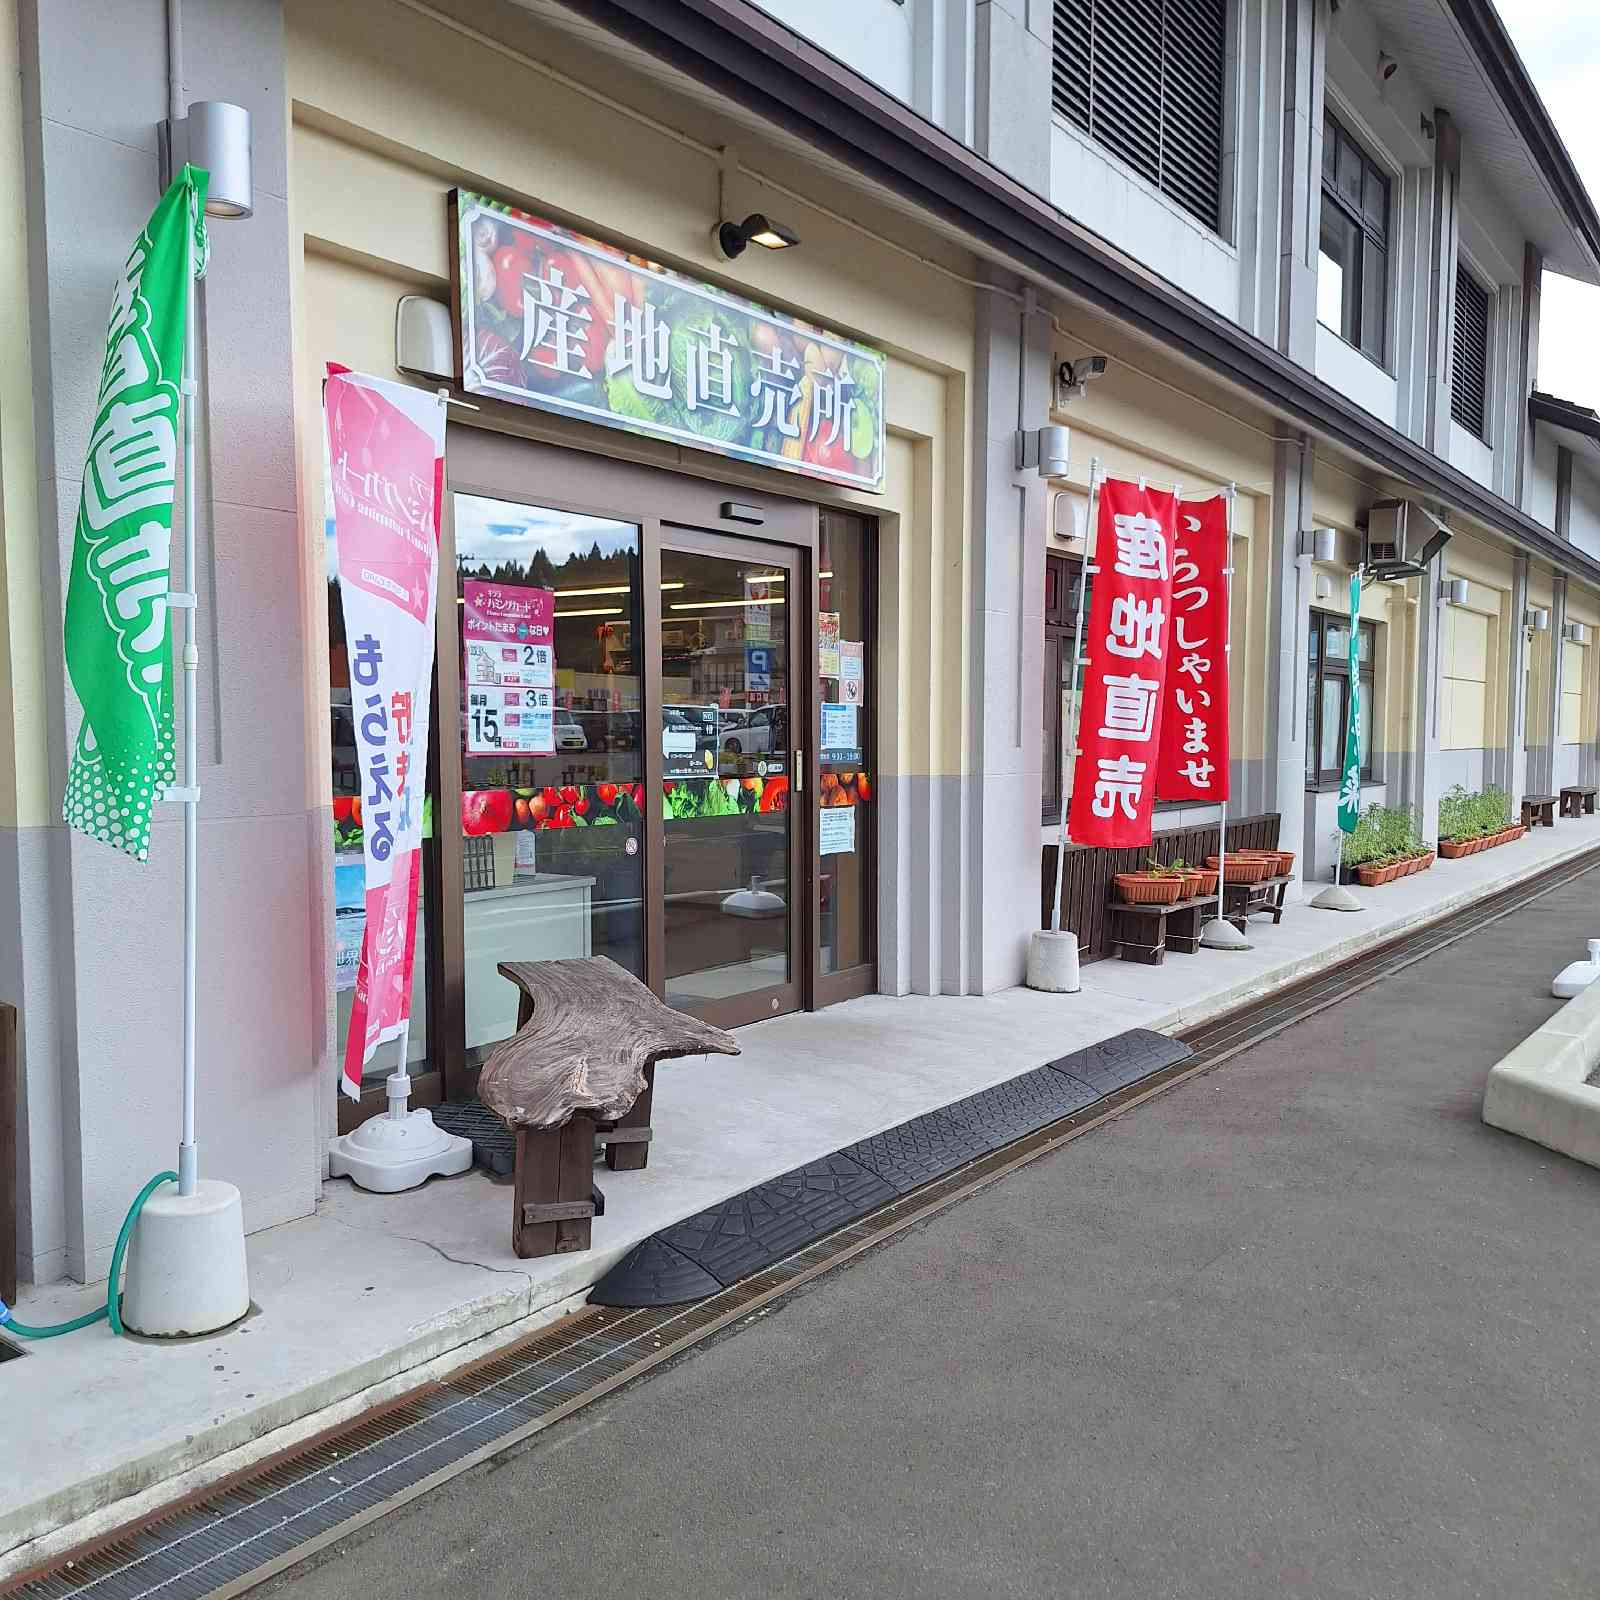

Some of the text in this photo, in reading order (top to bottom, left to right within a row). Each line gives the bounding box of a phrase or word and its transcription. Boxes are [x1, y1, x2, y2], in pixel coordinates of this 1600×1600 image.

[519, 266, 857, 452] 産地直売所
[523, 645, 547, 665] 2倍
[526, 689, 549, 708] 3倍
